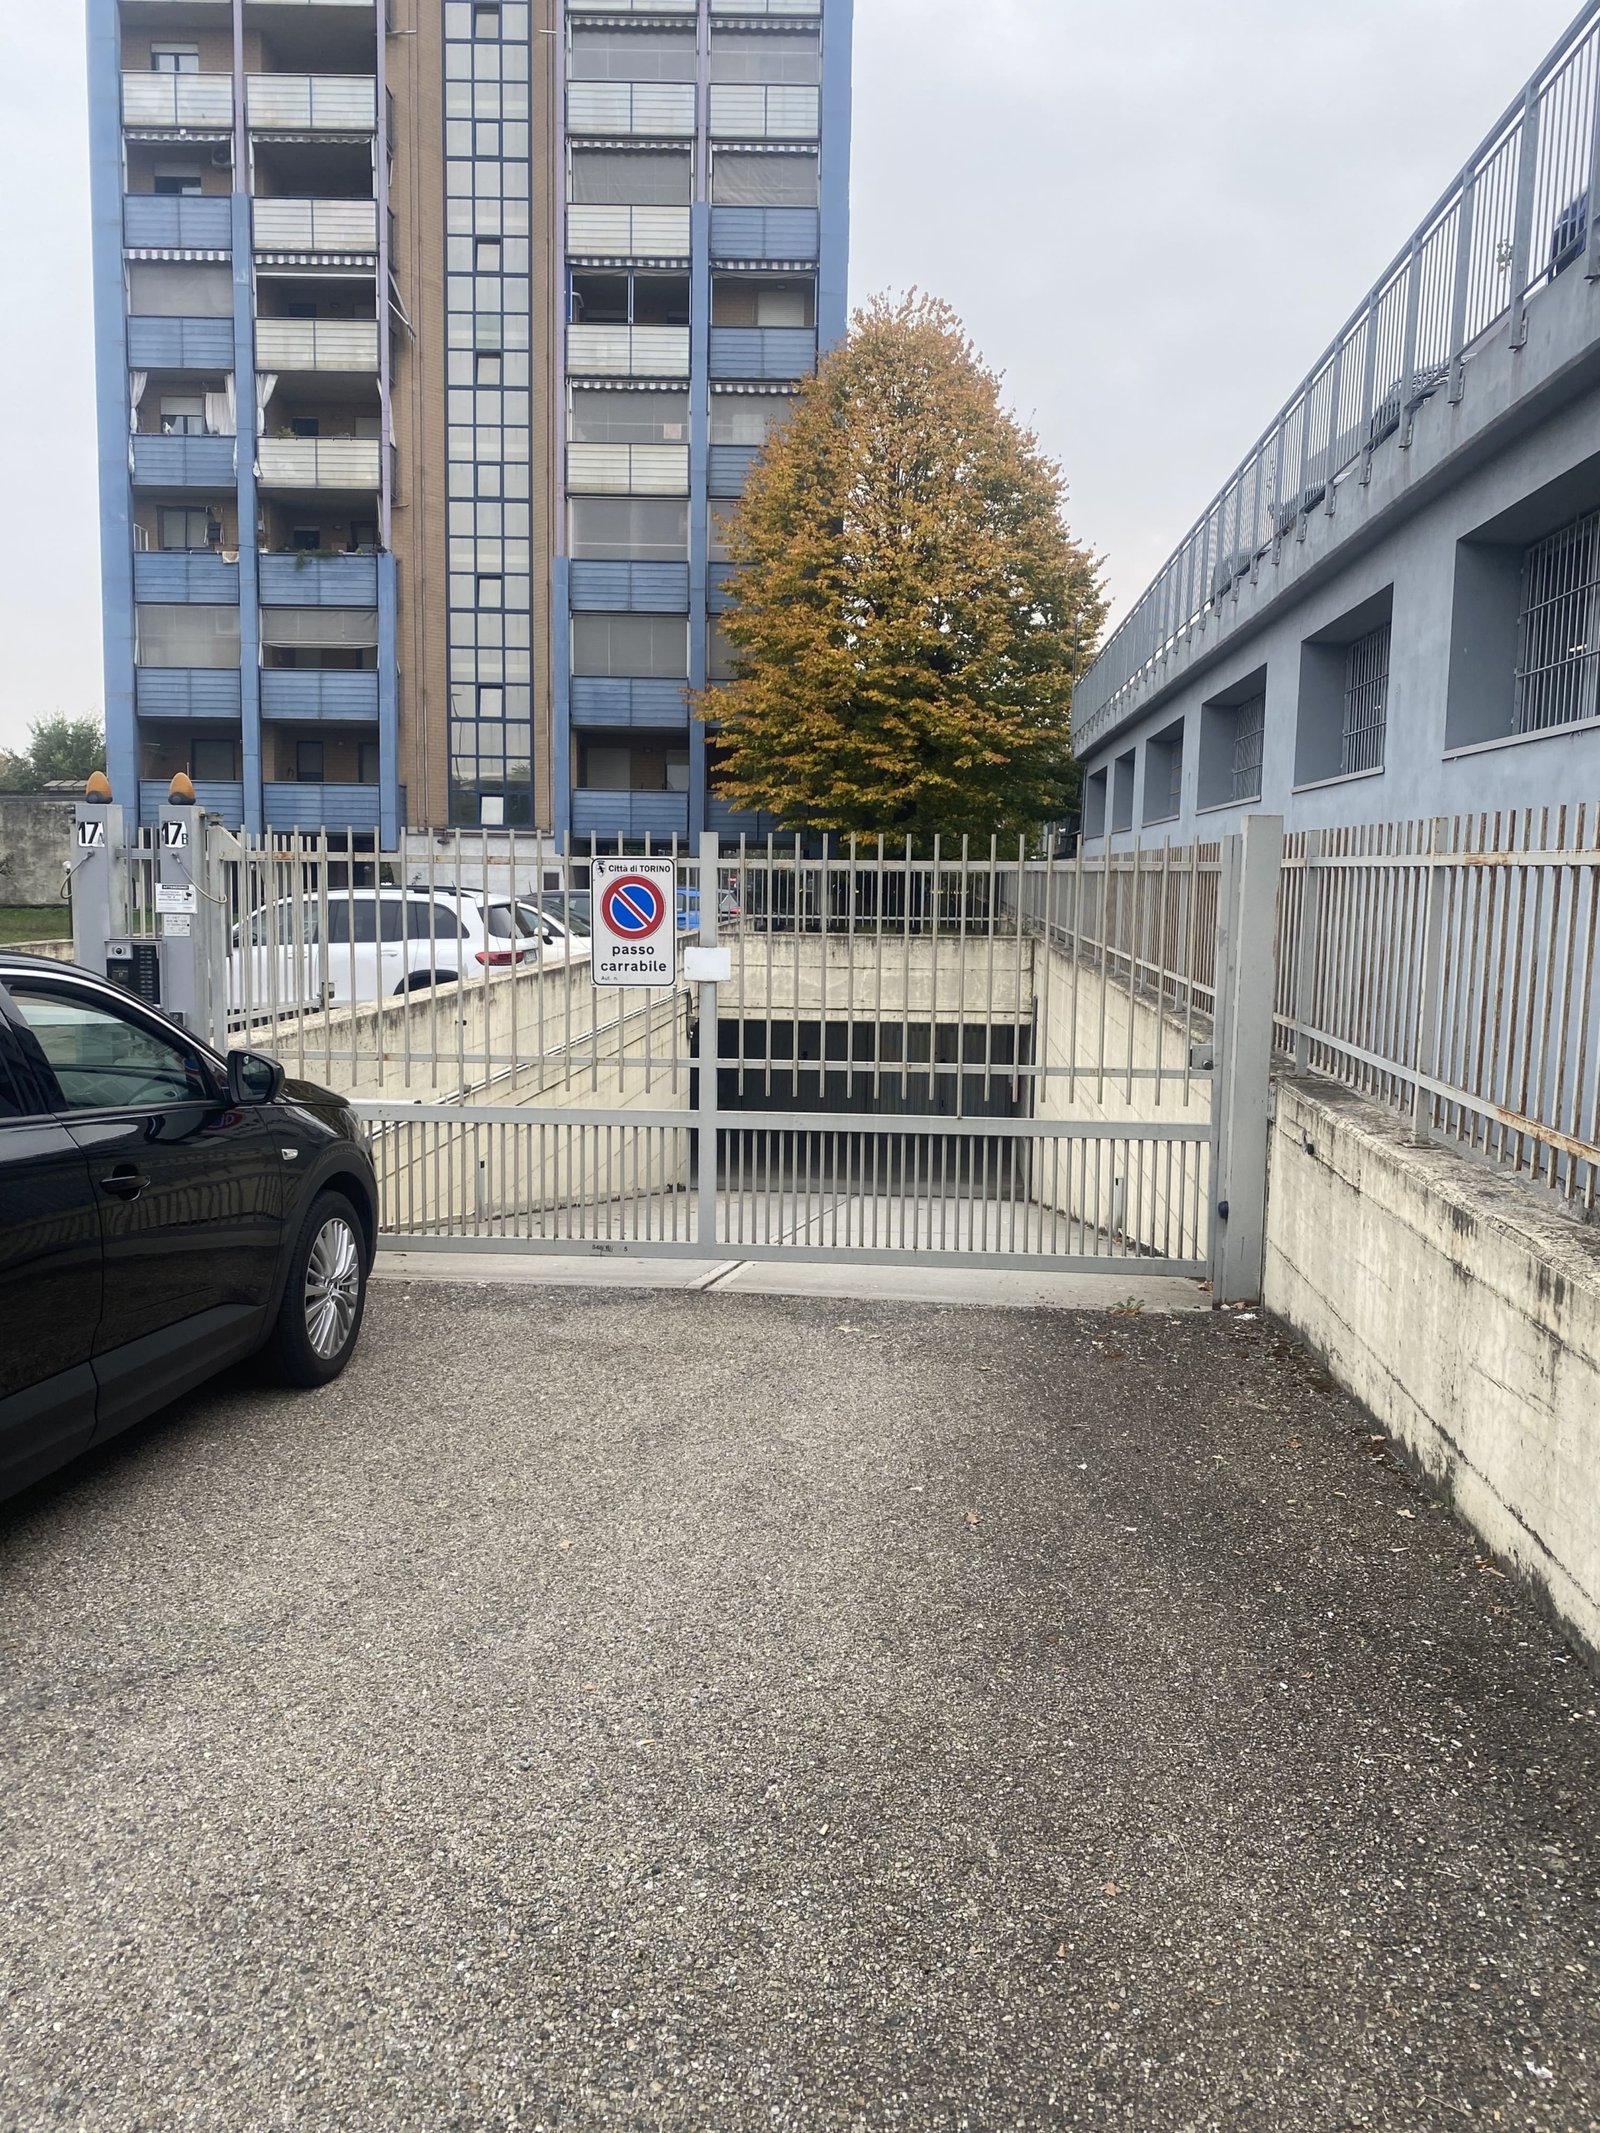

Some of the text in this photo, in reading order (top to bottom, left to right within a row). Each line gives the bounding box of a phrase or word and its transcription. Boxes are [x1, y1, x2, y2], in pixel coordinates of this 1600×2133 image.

[608, 864, 628, 872] Città
[612, 946, 655, 957] passo
[600, 960, 667, 972] carrabile
